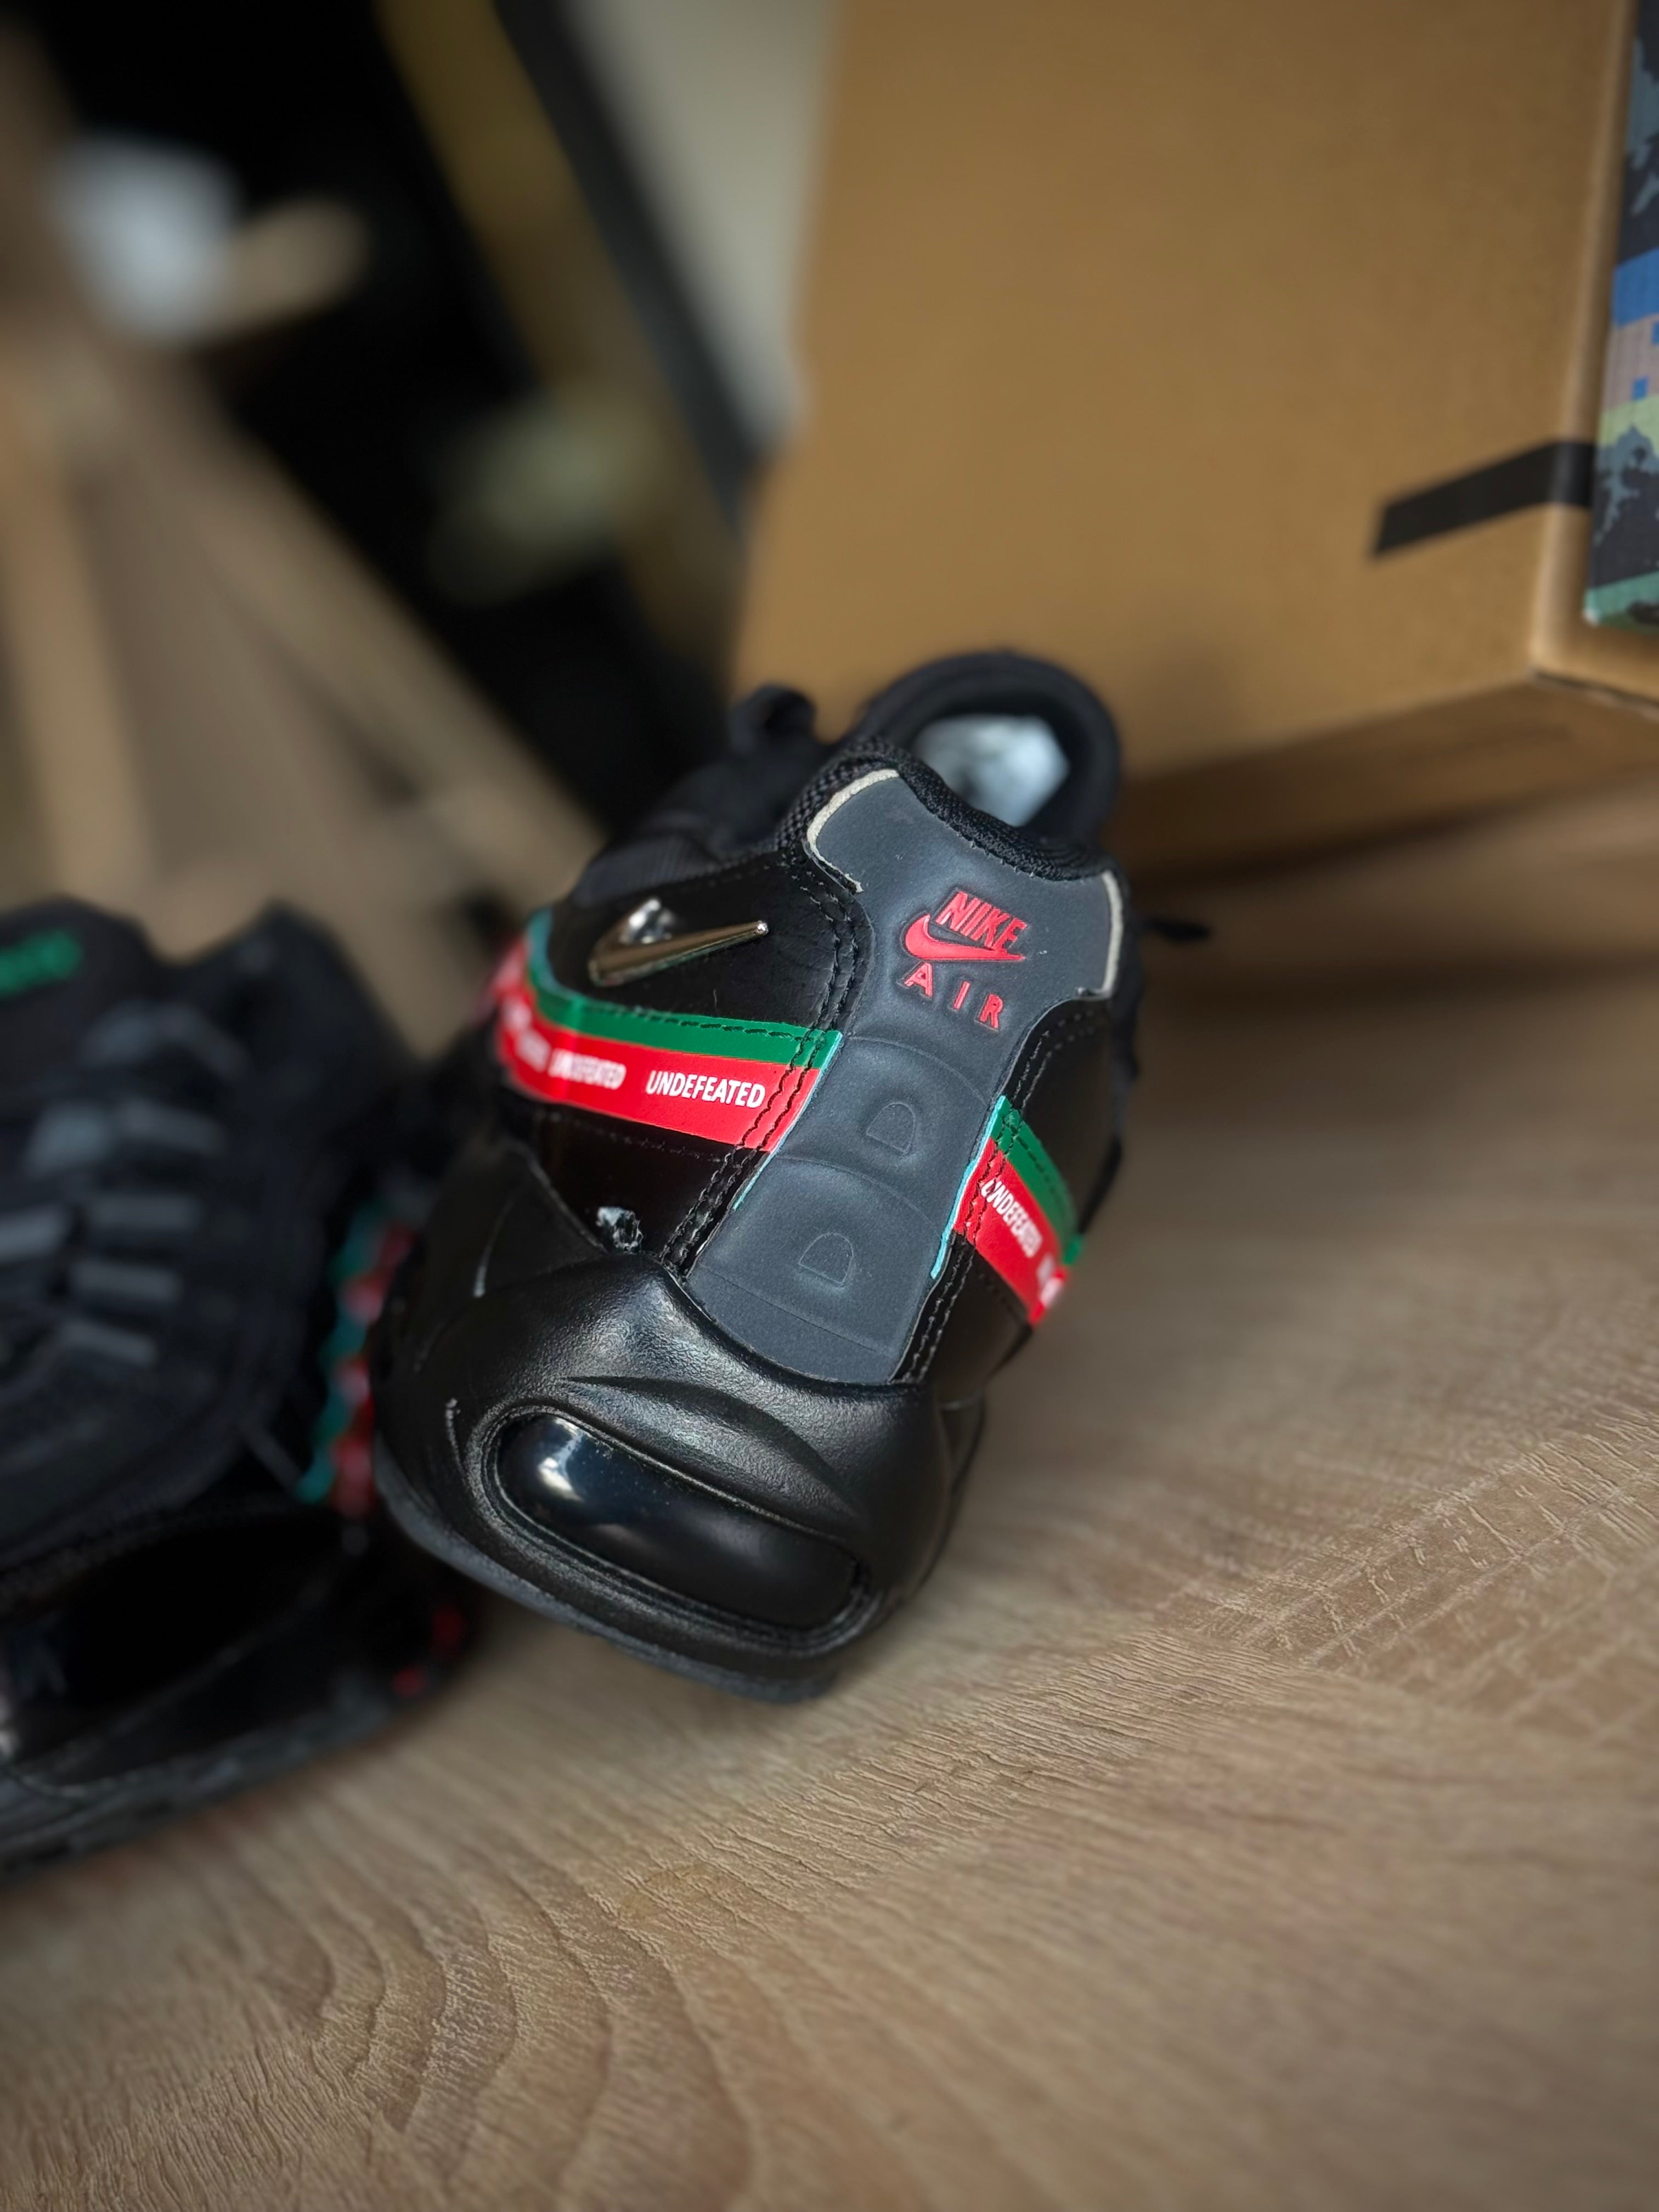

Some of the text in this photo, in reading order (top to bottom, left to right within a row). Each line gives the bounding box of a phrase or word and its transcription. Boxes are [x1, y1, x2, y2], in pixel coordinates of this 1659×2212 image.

[935, 891, 1028, 953] NIKE
[904, 962, 1003, 1029] AIR
[646, 1070, 766, 1109] UNDEFEATED
[981, 1177, 1042, 1258] UNDEFE
